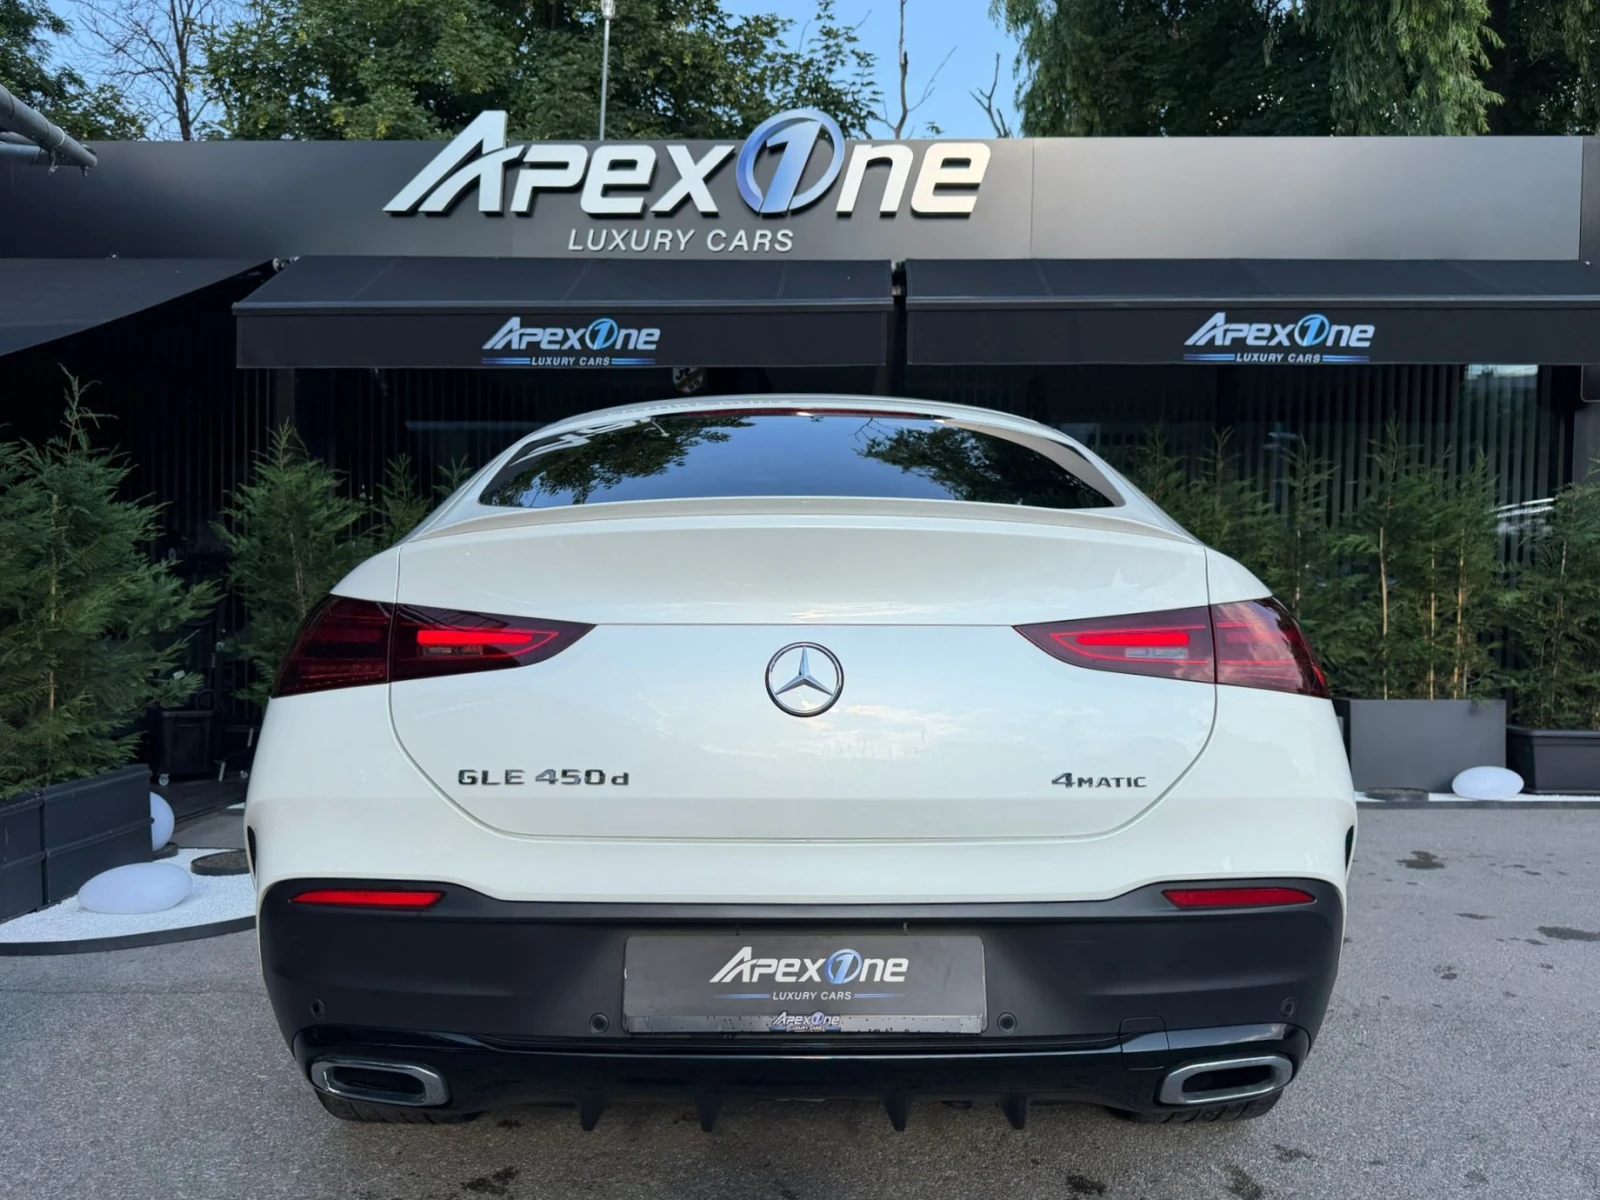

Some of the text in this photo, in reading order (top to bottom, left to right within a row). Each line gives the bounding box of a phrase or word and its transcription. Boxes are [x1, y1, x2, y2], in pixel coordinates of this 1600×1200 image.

[568, 229, 794, 253] LUXURY CARS
[531, 356, 611, 366] LUXURY CARS
[1236, 353, 1321, 363] LUXURY CARS
[458, 769, 526, 786] GLE
[1051, 772, 1147, 788] 4MATIC
[772, 991, 852, 1001] LUXURY CARS
